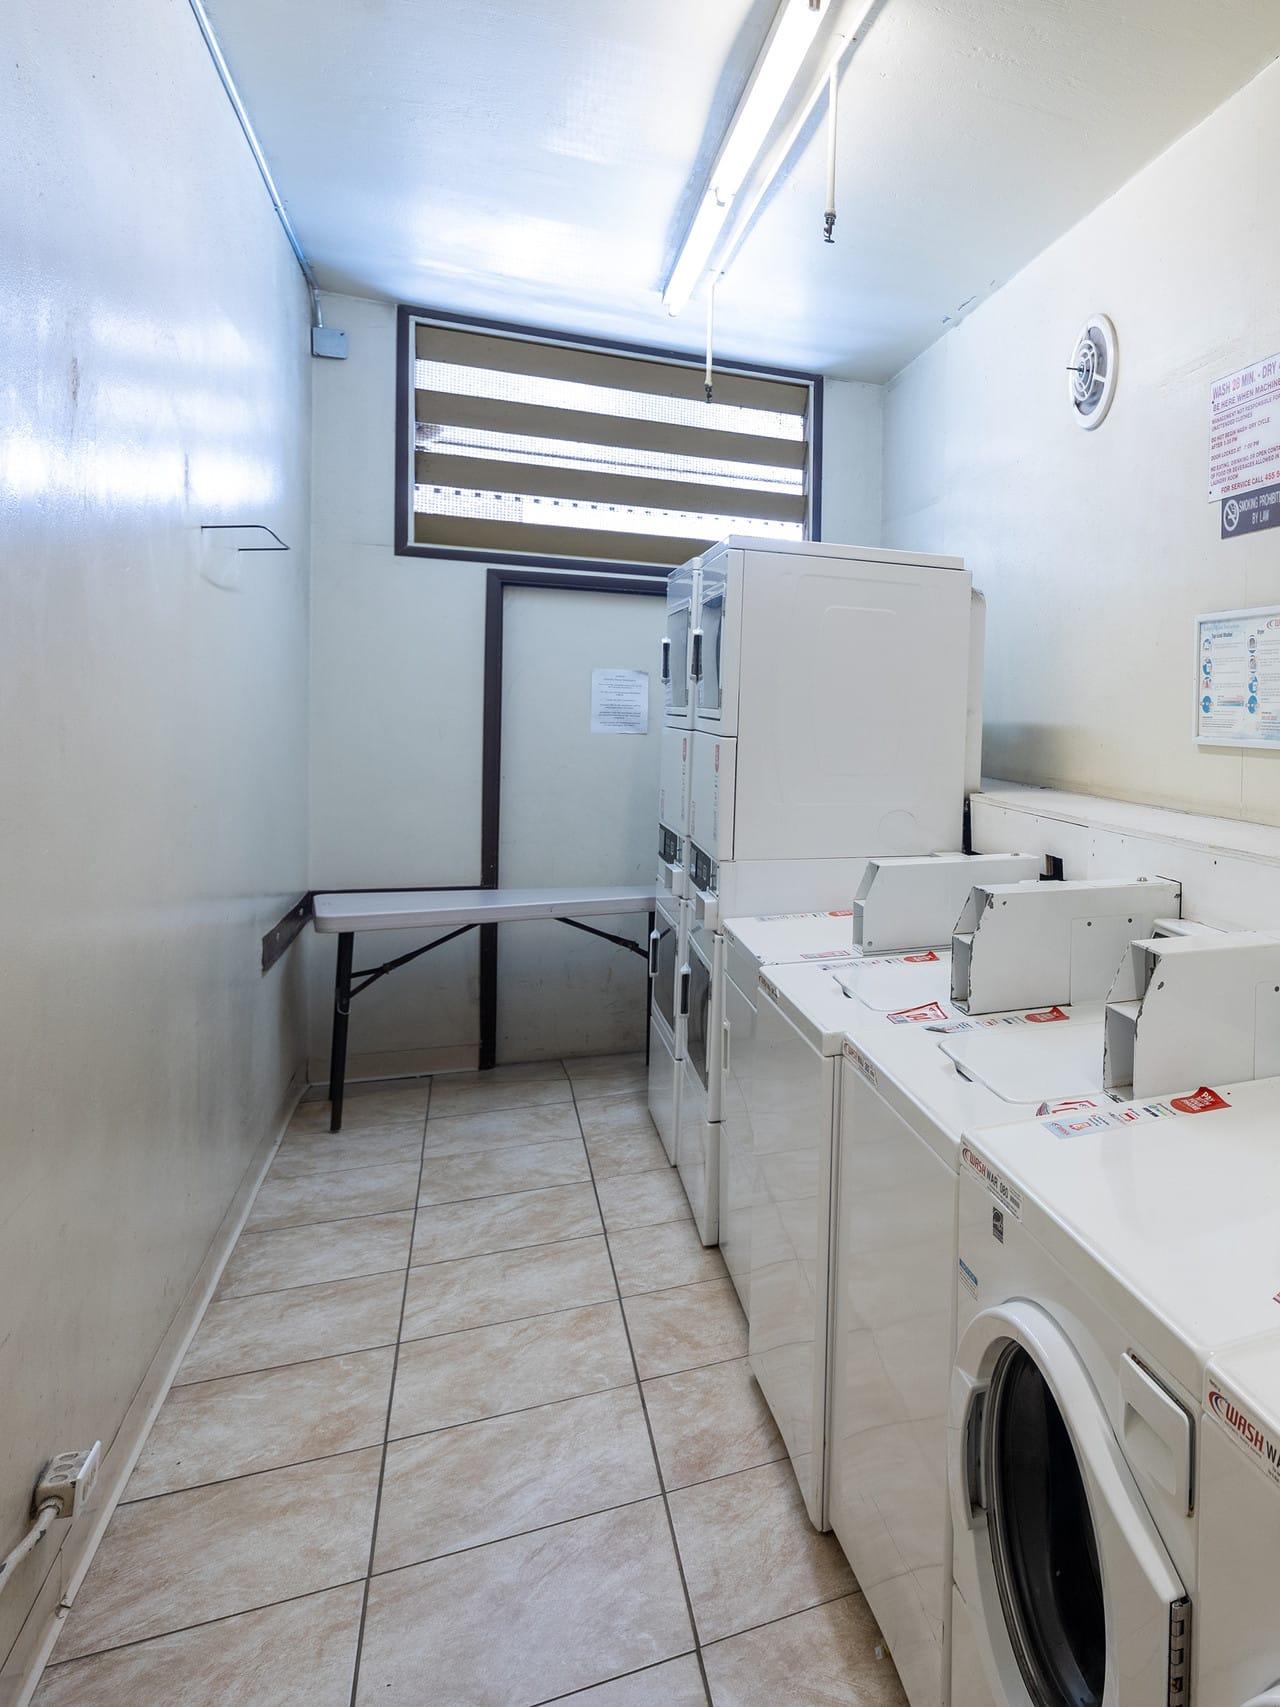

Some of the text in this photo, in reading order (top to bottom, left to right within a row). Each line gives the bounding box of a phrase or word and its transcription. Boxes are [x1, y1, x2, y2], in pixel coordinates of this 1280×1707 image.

[1213, 381, 1230, 399] WASH
[1242, 371, 1255, 387] MIN.
[1262, 362, 1276, 378] DRY
[1221, 397, 1235, 408] HERE
[1237, 390, 1254, 401] WHEN
[1256, 450, 1267, 458] OPEN
[1256, 456, 1274, 465] ALLOWED
[1221, 486, 1230, 494] FOR
[1232, 480, 1251, 491] SERVICE
[1252, 476, 1263, 485] CALL
[1239, 496, 1258, 512] SMOKING
[1252, 509, 1270, 524] BY LAW
[969, 1152, 986, 1177] WASH
[1226, 1402, 1264, 1452] WASH
